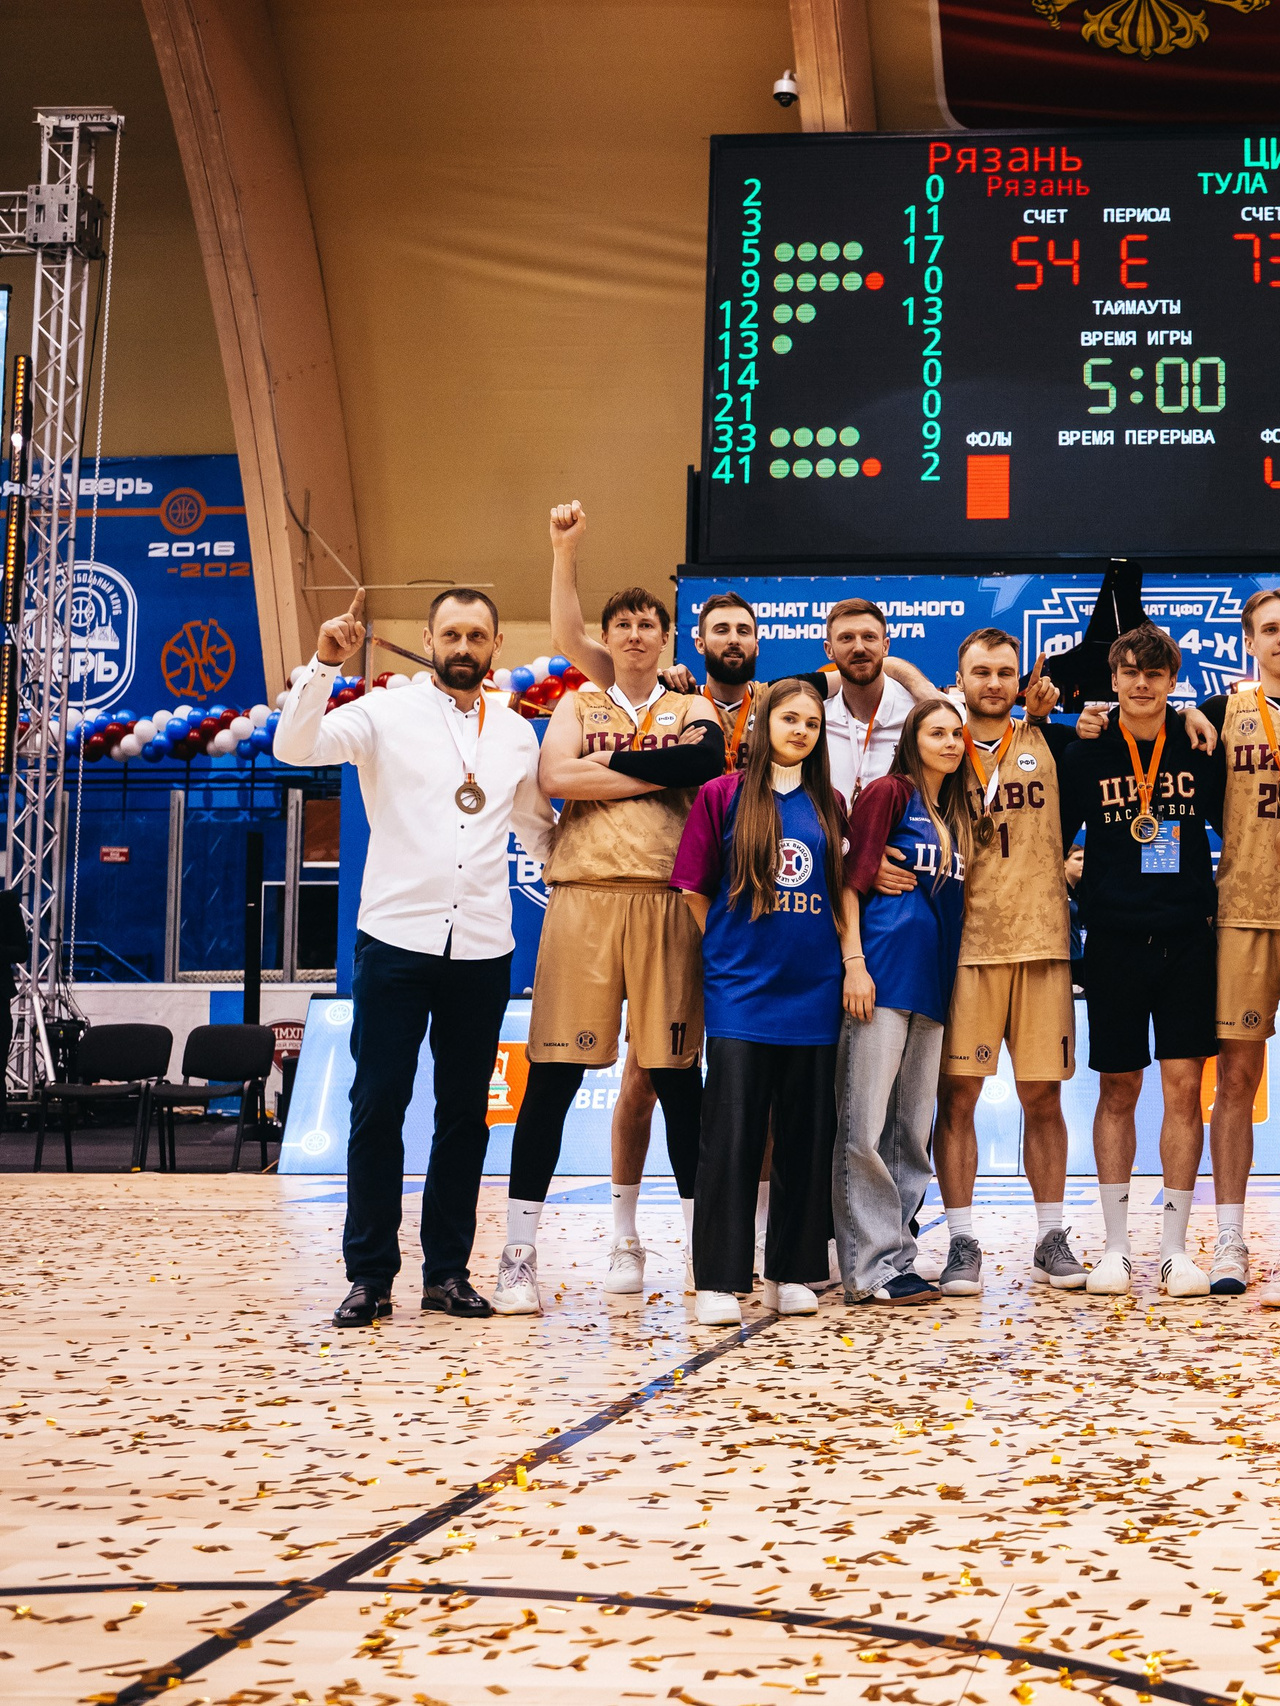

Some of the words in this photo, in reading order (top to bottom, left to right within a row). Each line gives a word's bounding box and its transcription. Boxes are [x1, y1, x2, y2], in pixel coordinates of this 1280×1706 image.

[929, 142, 1082, 173] Рязань
[743, 178, 761, 206] 2
[926, 175, 944, 202] 0
[987, 176, 1090, 197] Рязань
[1198, 172, 1268, 194] ТУЛА
[742, 209, 761, 237] 3
[904, 205, 938, 233] 11
[1024, 209, 1068, 223] СЧЕТ
[1104, 208, 1170, 223] ПЕРИОД
[742, 239, 760, 267] 5
[904, 235, 944, 263] 17
[1011, 236, 1079, 290] 54
[742, 269, 759, 297] 9
[924, 266, 942, 294] 0
[720, 300, 758, 329] 12
[902, 297, 942, 325] 13
[1093, 300, 1180, 315] ТАЙМАУТЫ
[719, 331, 758, 359] 13
[923, 328, 942, 356] 2
[1081, 331, 1136, 346] ВРЕМЯ
[1148, 331, 1192, 345] ИГРЫ
[718, 361, 759, 390] 14
[923, 358, 941, 387] 0
[1083, 358, 1226, 413] 5:00
[714, 393, 751, 422] 21
[923, 389, 941, 418] 0
[714, 424, 756, 453] 33
[922, 421, 941, 449] 9
[966, 431, 1012, 446] ФОЛЫ
[1059, 430, 1114, 445] ВРЕМЯ
[1125, 429, 1215, 444] ПЕРЕРЫВА
[712, 455, 750, 484] 41
[921, 452, 940, 481] 2
[148, 542, 235, 557] 2016
[1169, 604, 1203, 618] ЦФО
[996, 822, 1010, 858] 1
[670, 1022, 687, 1056] 11
[1060, 1035, 1069, 1069] 1
